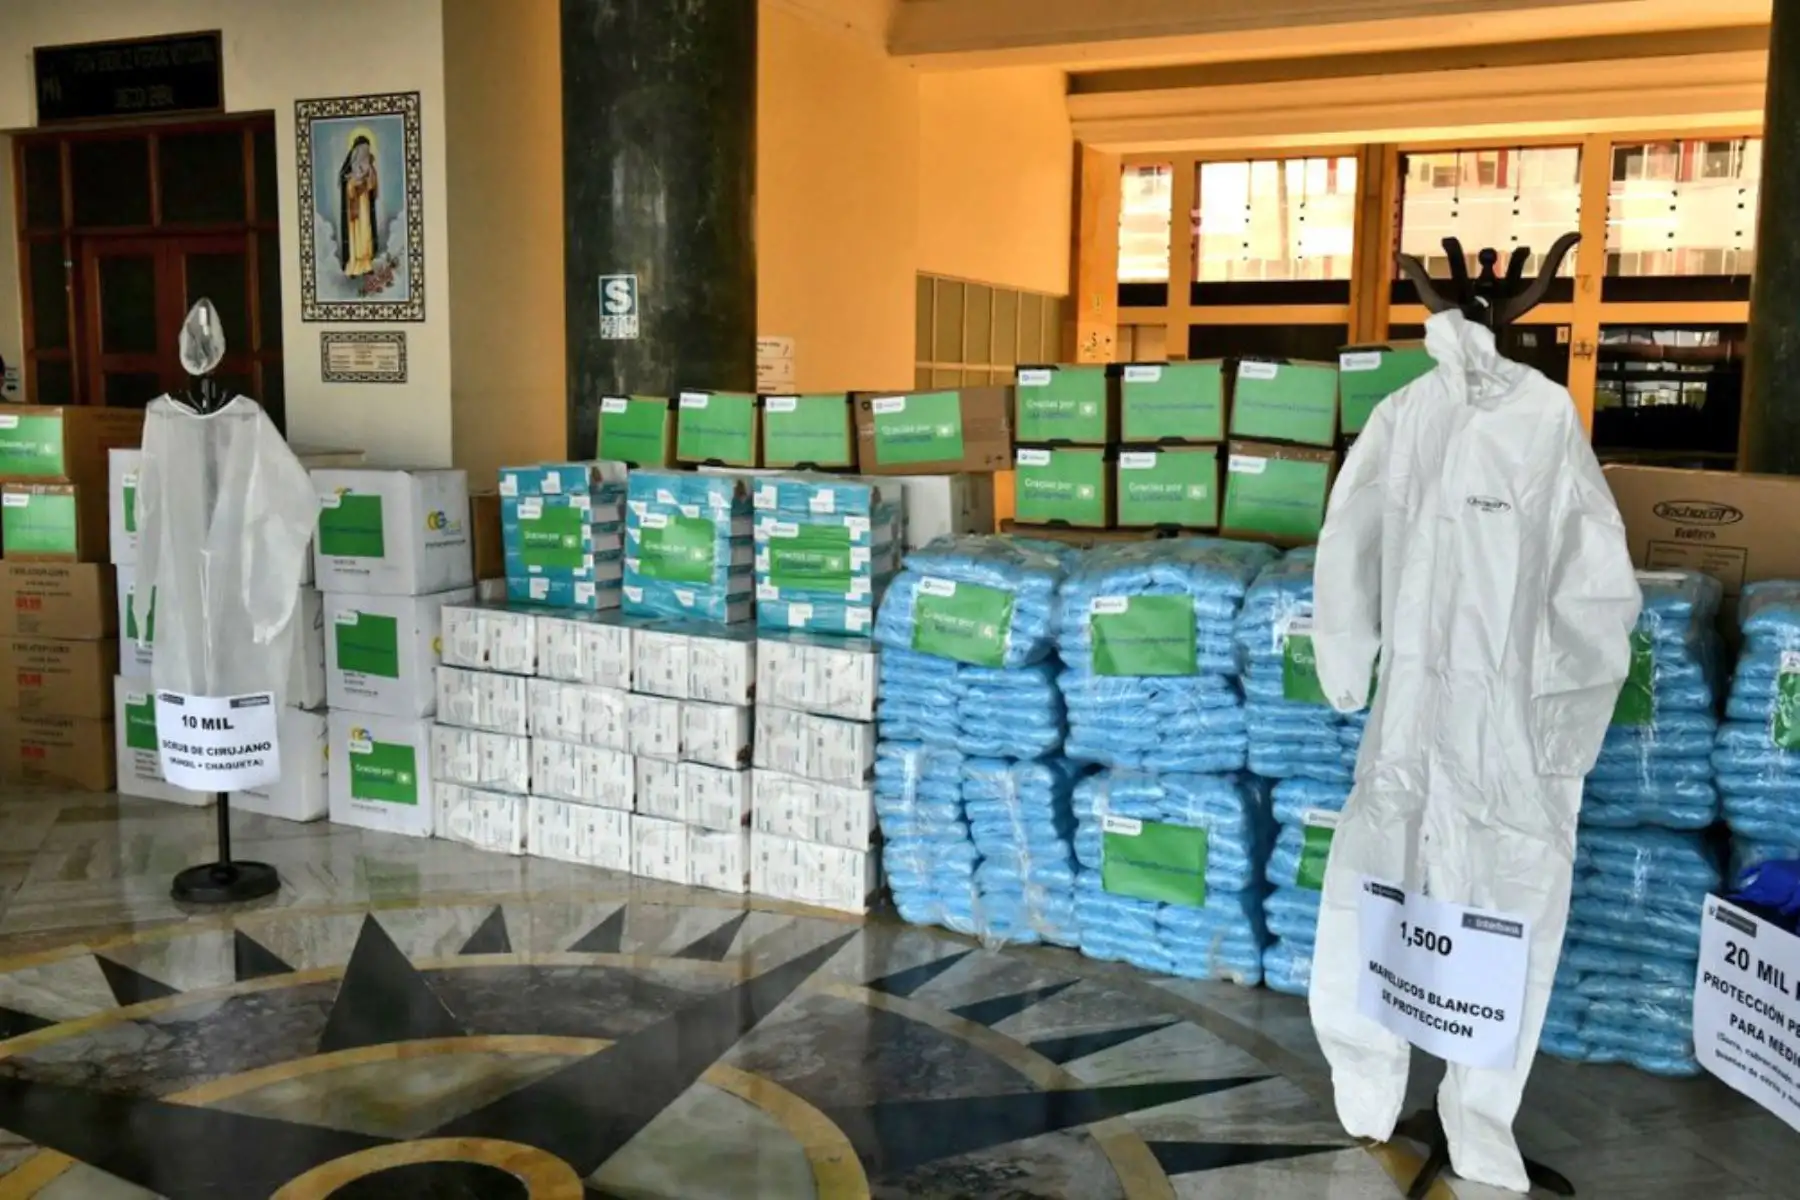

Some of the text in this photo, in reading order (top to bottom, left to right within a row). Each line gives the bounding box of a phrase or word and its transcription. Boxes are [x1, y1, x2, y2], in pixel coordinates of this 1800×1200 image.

[605, 280, 632, 312] S
[182, 714, 235, 730] 10 MIL
[190, 746, 203, 756] DE
[206, 741, 272, 756] CIRUJANO
[1400, 921, 1453, 956] 1,500
[1724, 941, 1750, 971] 20
[1757, 960, 1789, 995] MIL
[1382, 988, 1474, 1038] DE PROTECCIÓN
[1428, 992, 1505, 1022] BLANCOS
[1729, 1013, 1765, 1044] PARA
